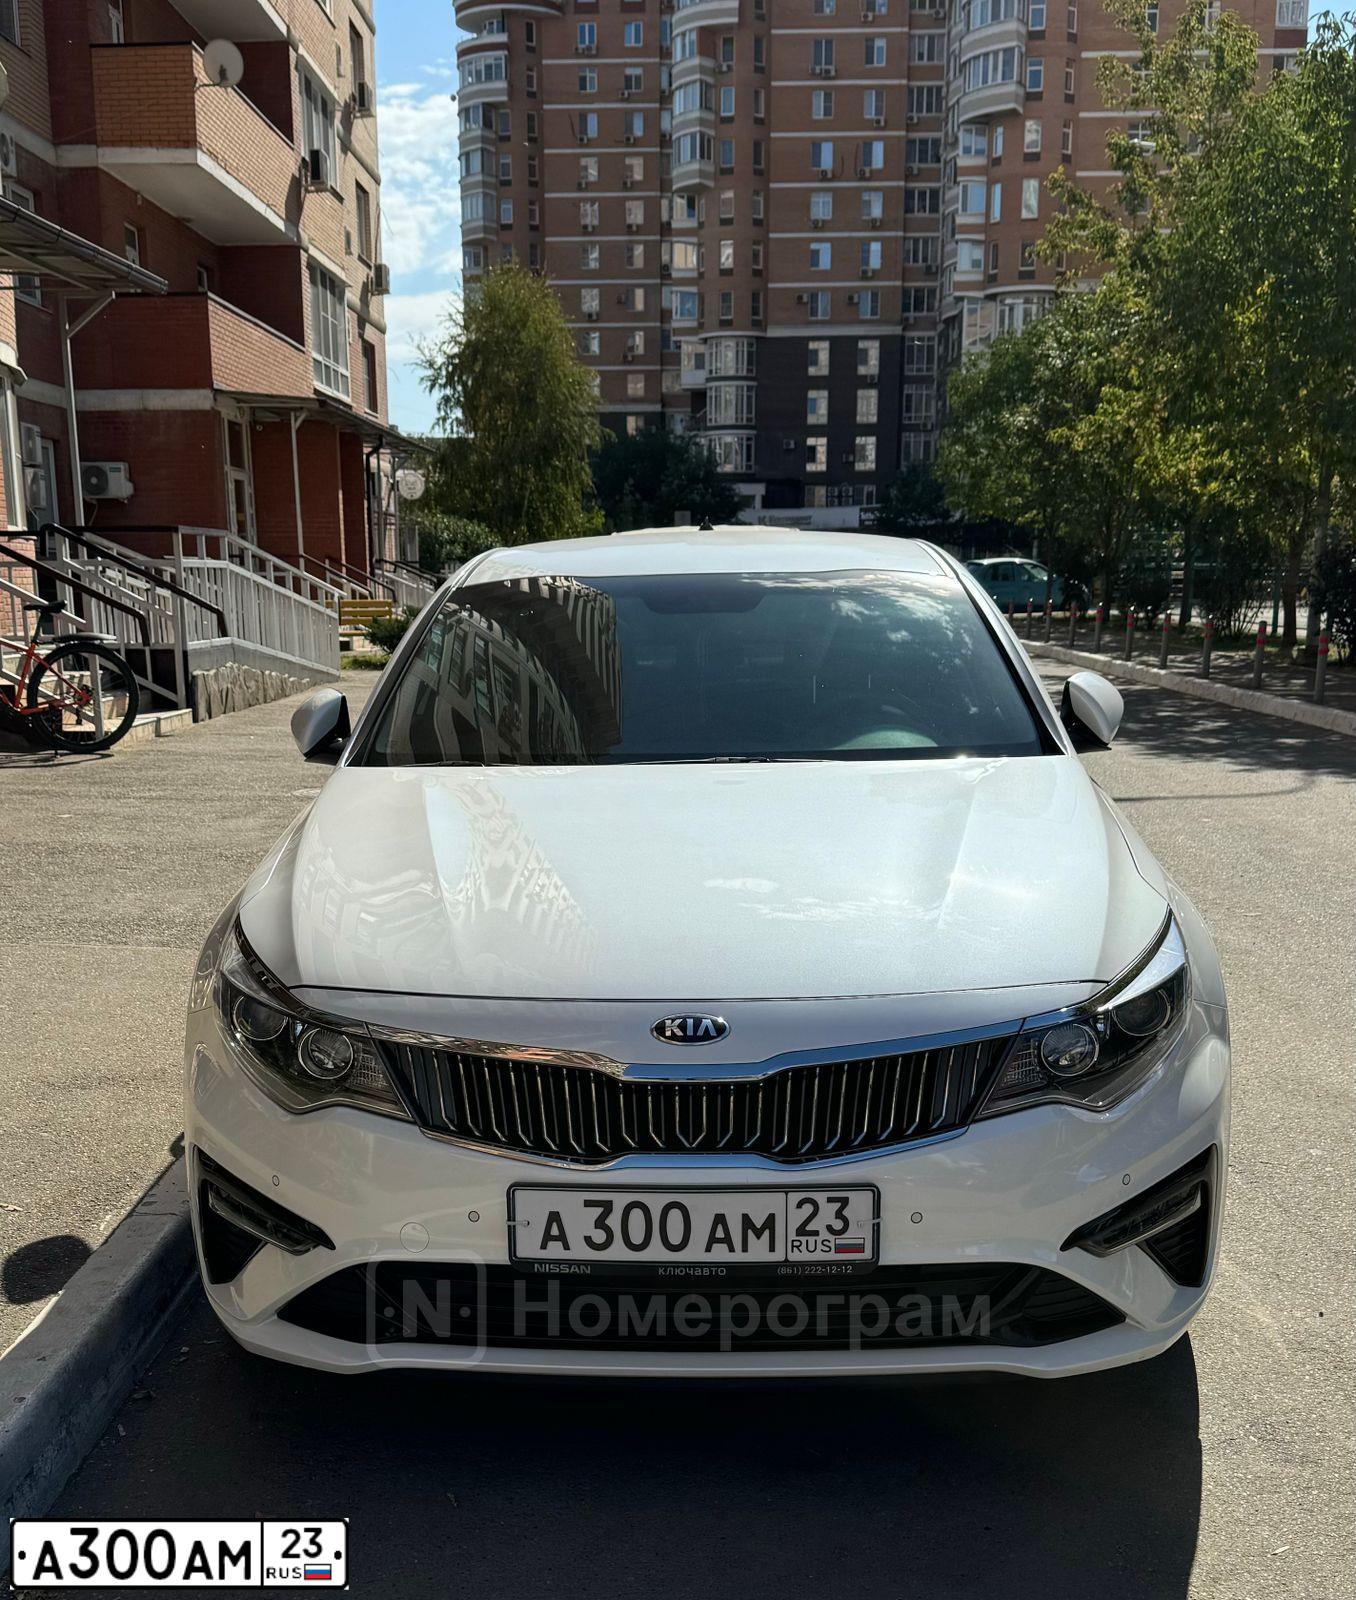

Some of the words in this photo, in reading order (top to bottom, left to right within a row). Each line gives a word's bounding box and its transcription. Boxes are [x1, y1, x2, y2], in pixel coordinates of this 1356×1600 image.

[664, 1017, 718, 1037] KIA
[795, 1196, 850, 1237] 23
[791, 1239, 832, 1254] RUS
[534, 1263, 591, 1274] NISSAN
[658, 1266, 727, 1276] ключавто
[777, 1265, 801, 1275] (861)
[804, 1265, 853, 1275] 222-12-12
